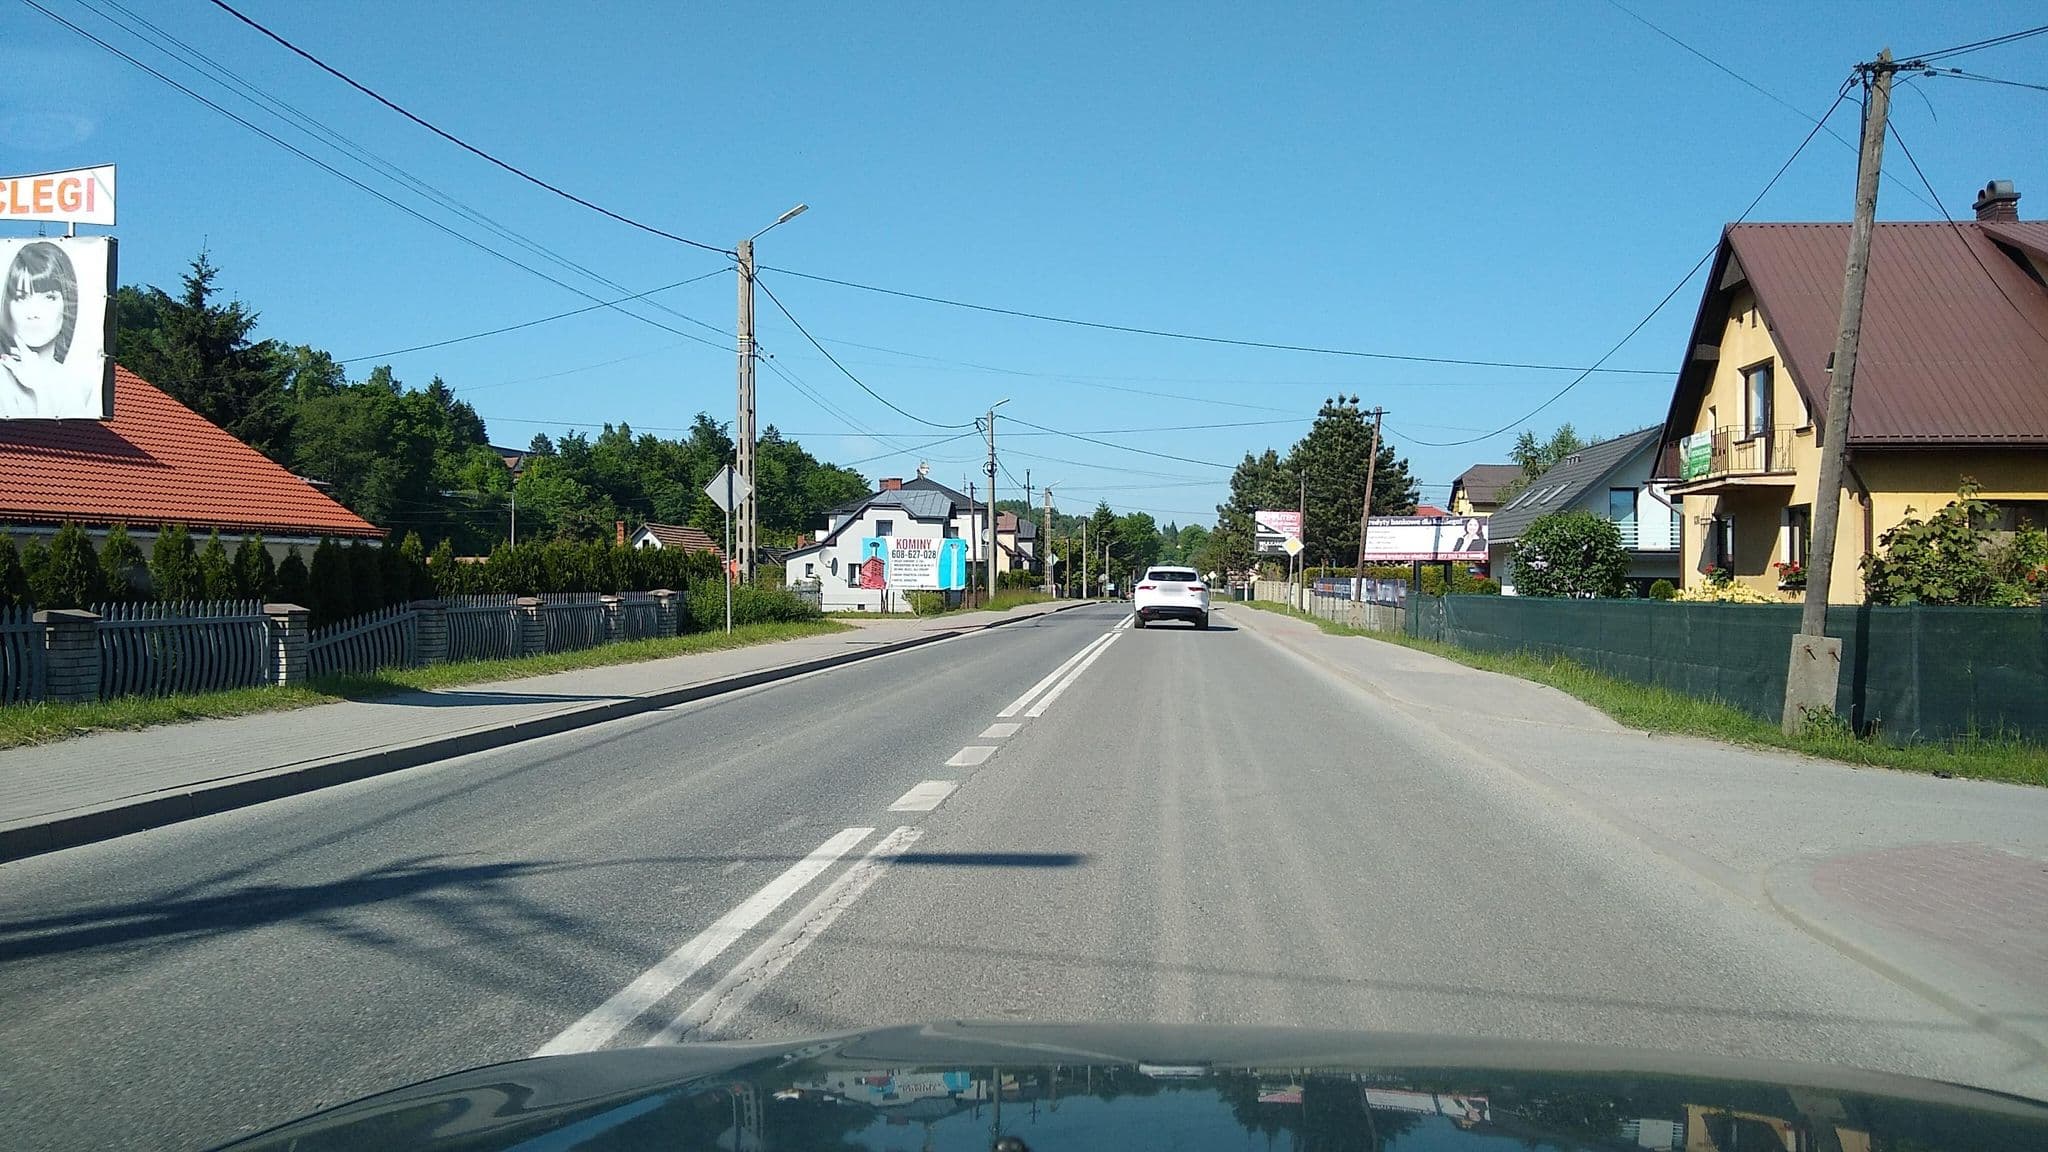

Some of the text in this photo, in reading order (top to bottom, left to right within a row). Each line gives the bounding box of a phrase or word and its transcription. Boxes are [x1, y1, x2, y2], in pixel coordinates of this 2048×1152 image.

[0, 177, 95, 214] LEGI
[896, 538, 932, 550] KOMINY
[891, 550, 937, 559] 608-627-028
